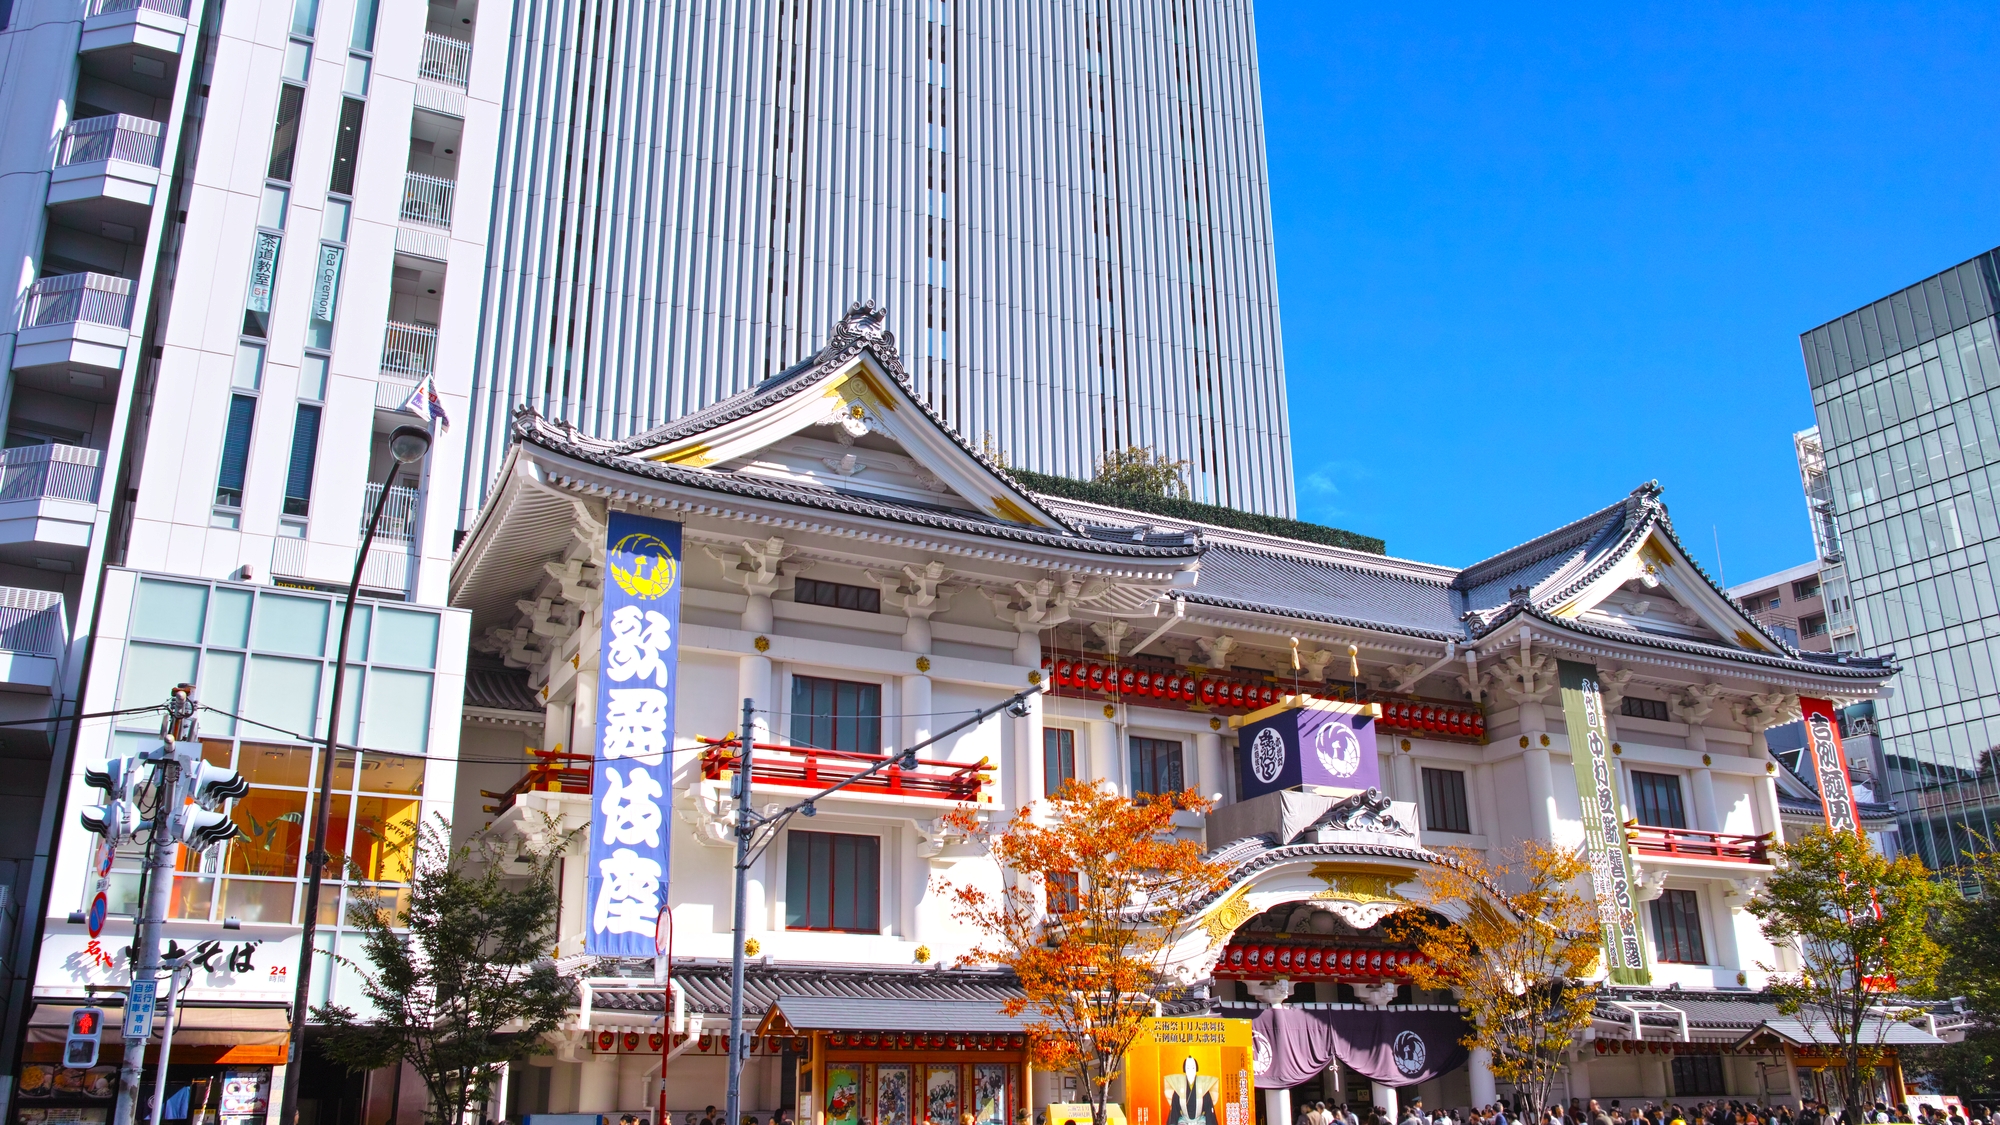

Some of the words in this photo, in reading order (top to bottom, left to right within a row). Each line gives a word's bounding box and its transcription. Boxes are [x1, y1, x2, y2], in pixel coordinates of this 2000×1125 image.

[255, 234, 276, 286] 茶道教室
[326, 248, 338, 266] Tea
[254, 287, 268, 297] 5F
[316, 268, 334, 320] Ceremony
[594, 605, 671, 938] 歌舞伎座
[83, 940, 113, 968] 名代
[125, 939, 263, 973] 士そば
[270, 966, 287, 976] 24
[131, 984, 143, 1012] 自転車
[142, 984, 153, 1012] 歩行者
[133, 1014, 144, 1034] 専用
[1154, 1021, 1225, 1031] 芸術祭十月大歌舞伎
[1154, 1033, 1226, 1043] 吉例顔見世大歌舞伎
